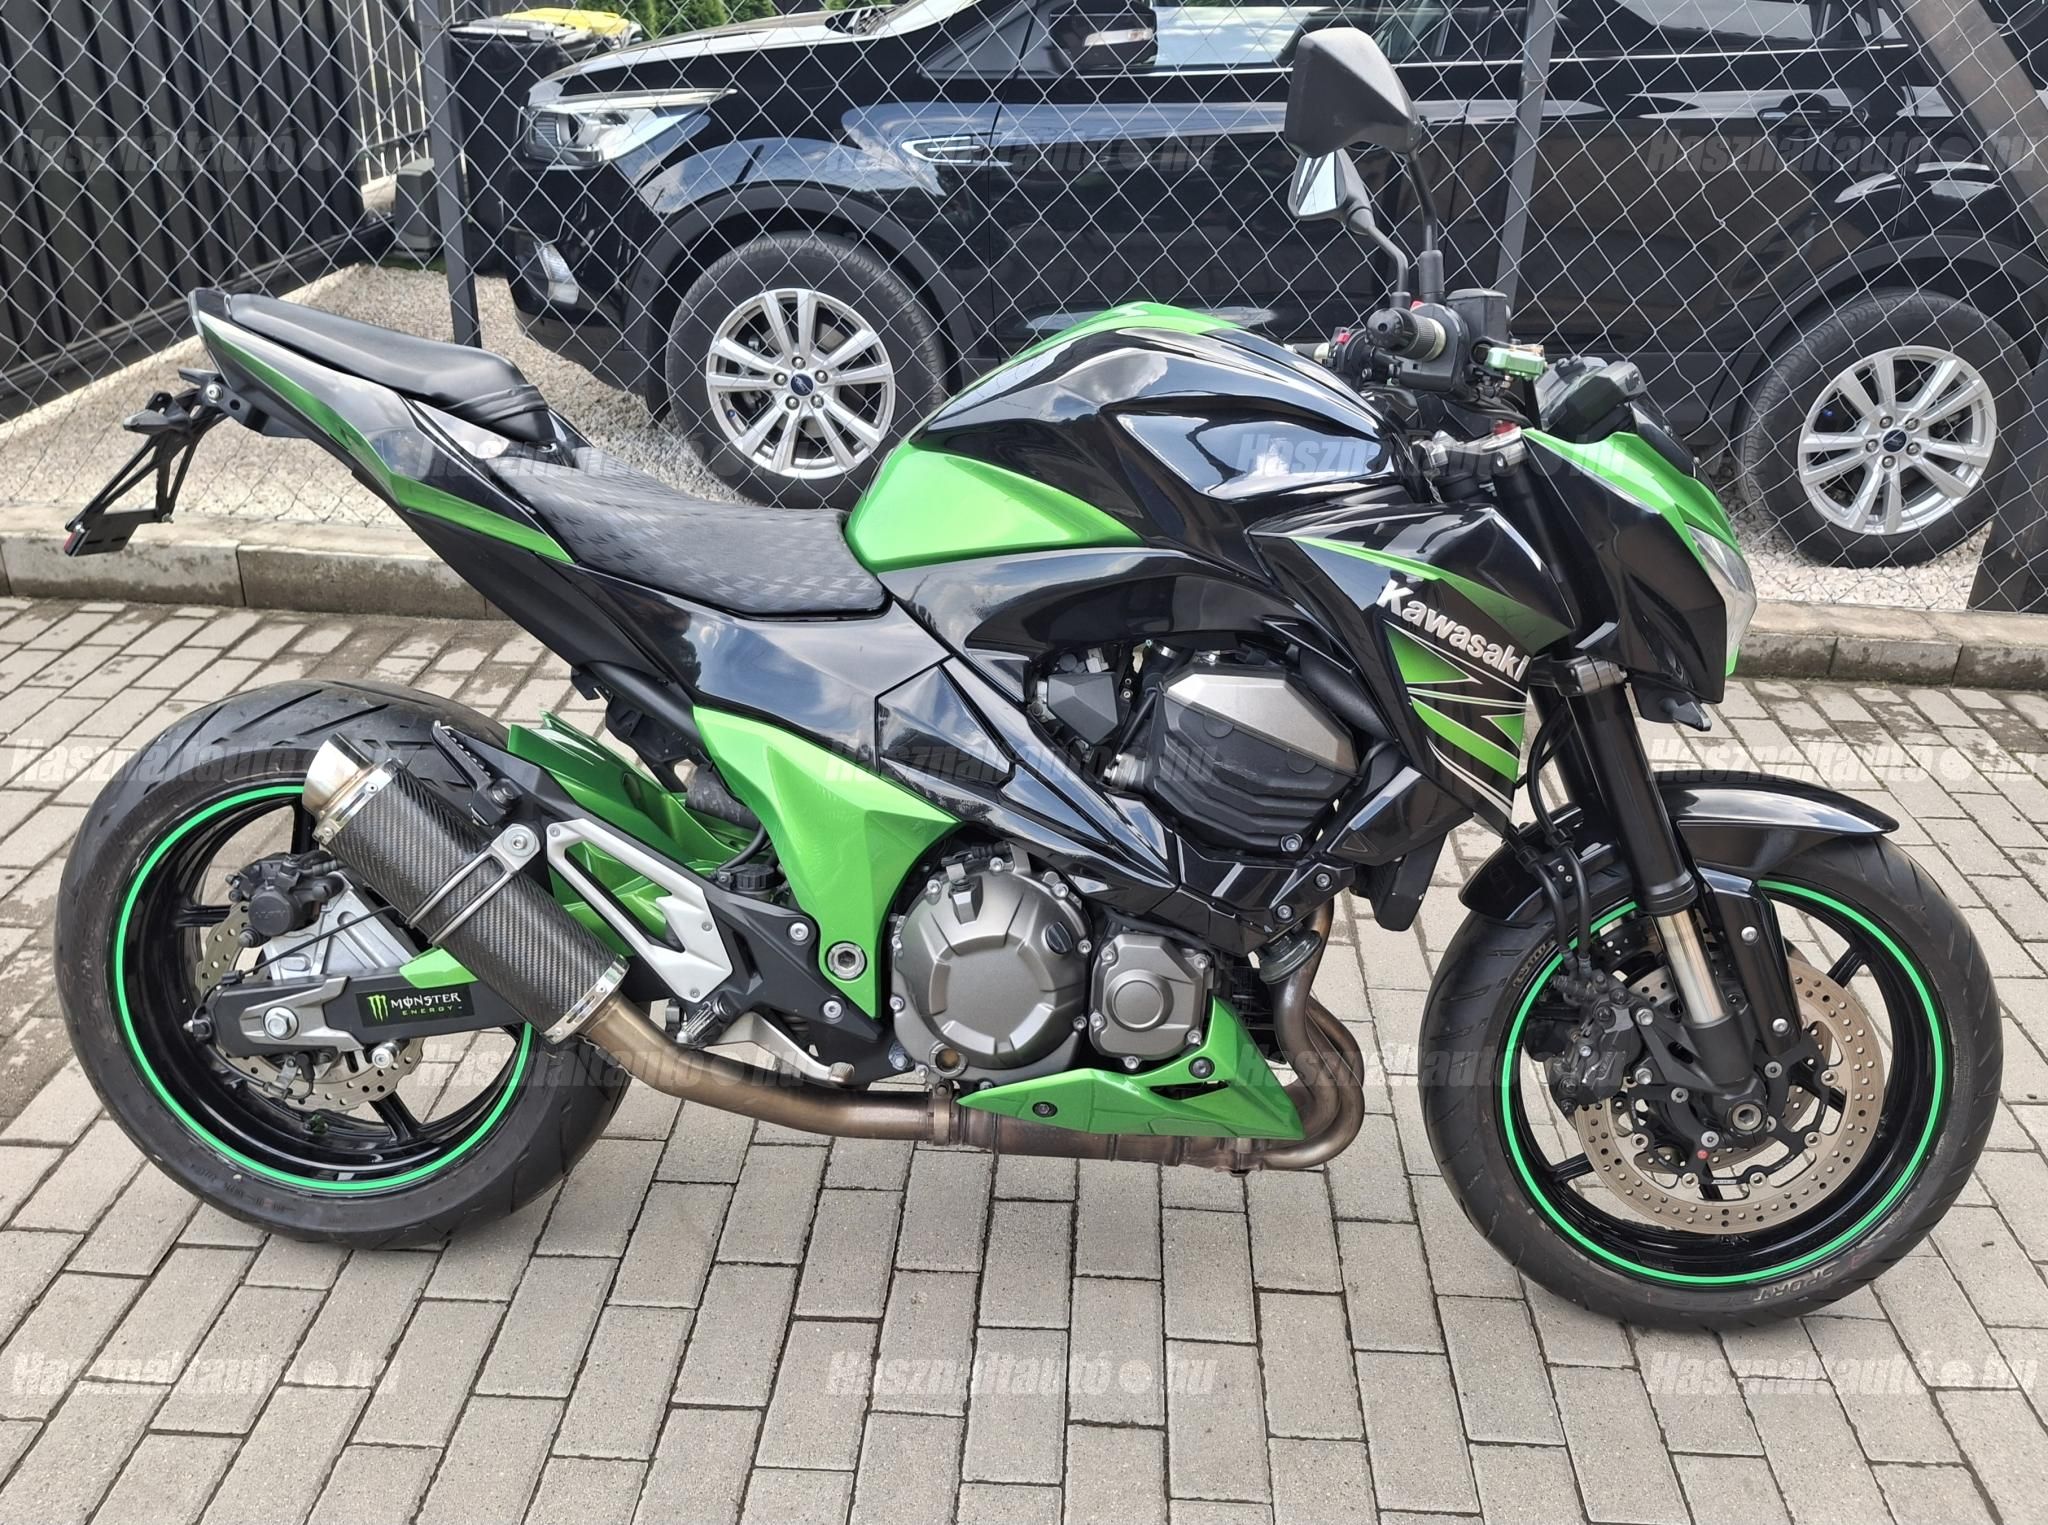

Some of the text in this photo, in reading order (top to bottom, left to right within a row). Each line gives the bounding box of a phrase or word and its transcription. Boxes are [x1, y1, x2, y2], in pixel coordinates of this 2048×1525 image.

[1376, 579, 1531, 682] Kawasaki
[390, 992, 462, 1010] MONSTER
[402, 1005, 453, 1016] ENERGY
